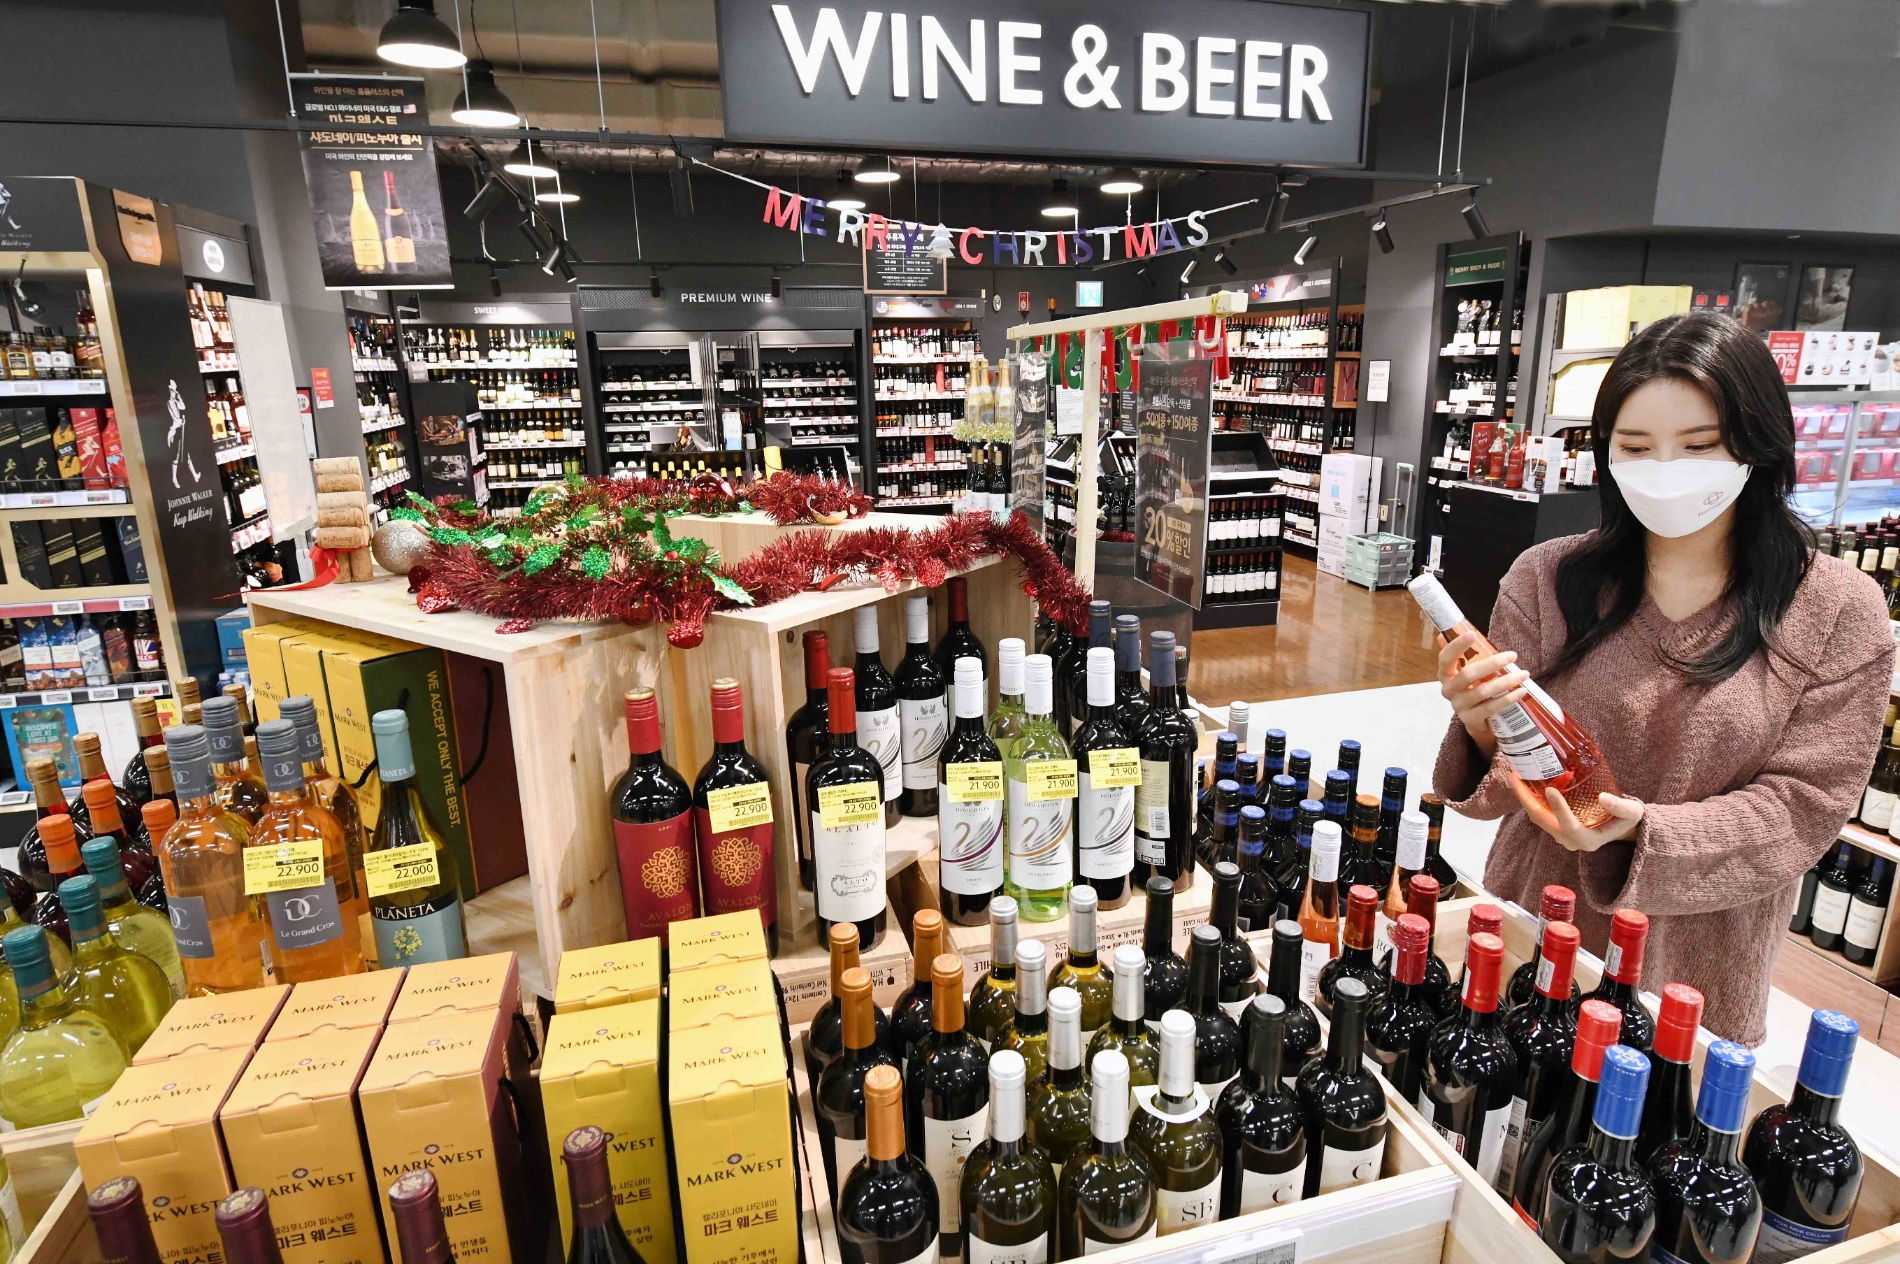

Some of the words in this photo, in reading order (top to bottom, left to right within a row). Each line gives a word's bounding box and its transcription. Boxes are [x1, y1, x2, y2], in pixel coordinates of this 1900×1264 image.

[771, 4, 1043, 105] WINE
[1063, 23, 1122, 110] &
[1141, 31, 1333, 122] BEER
[763, 186, 923, 257] MERRY
[958, 210, 1208, 265] CHRISTMAS
[681, 293, 737, 303] PREMIUM
[740, 293, 772, 303] WINE
[474, 306, 497, 314] SWEET
[167, 495, 191, 511] JOHNNIE
[191, 489, 213, 502] WALKER
[173, 513, 187, 527] Keep
[187, 507, 213, 521] Walking
[426, 670, 440, 690] WE
[254, 688, 269, 700] MARK
[315, 707, 325, 718] EST
[430, 693, 448, 738] ACCEPT
[25, 723, 57, 732] DISCOVER
[335, 712, 351, 726] MARK
[350, 719, 367, 733] WEST
[26, 730, 43, 738] LOVE
[28, 736, 47, 744] FIRST
[438, 740, 452, 770] ONLY
[1110, 767, 1139, 777] 21,900
[443, 771, 456, 796] THE
[969, 780, 1000, 791] 21,900
[1047, 778, 1075, 789] 21,900
[446, 795, 461, 828] BEST.
[735, 802, 768, 817] 22,900
[844, 802, 877, 814] 22,900
[277, 862, 319, 878] 22,900
[395, 863, 434, 880] 22,000
[716, 894, 762, 906] AVALON
[648, 902, 693, 921] AVALON
[281, 930, 290, 938] Le
[290, 926, 316, 937] Grand
[316, 920, 335, 932] Cros
[681, 938, 717, 947] MARK
[720, 930, 752, 940] WEST
[187, 939, 204, 947] Cros
[570, 968, 608, 979] MARK
[612, 961, 647, 972] WEST
[411, 985, 451, 996] MARK
[456, 977, 493, 988] WEST
[682, 994, 721, 1004] MARK
[724, 985, 760, 996] WEST
[790, 981, 816, 992] Contents
[801, 989, 827, 1000] Contents
[292, 1003, 334, 1015] MARK
[339, 995, 378, 1006] WEST
[166, 1022, 210, 1033] MARK
[216, 1014, 257, 1025] WEST
[558, 1038, 601, 1050] MARK
[605, 1029, 643, 1041] WEST
[385, 1048, 429, 1061] MARK
[435, 1039, 474, 1052] WEST
[684, 1057, 727, 1070] MARK
[730, 1048, 768, 1060] WEST
[253, 1069, 300, 1082] MARK
[306, 1059, 348, 1072] WEST
[112, 1093, 162, 1108] MARK
[169, 1083, 215, 1097] WEST
[612, 1136, 657, 1154] WEST
[951, 1129, 972, 1149] S
[382, 1158, 435, 1178] MARK
[438, 1148, 484, 1166] WEST
[686, 1167, 735, 1188] MARK
[740, 1157, 783, 1175] WEST
[1352, 1161, 1372, 1180] C
[263, 1182, 304, 1199] ARK
[306, 1171, 356, 1191] WEST
[1272, 1183, 1293, 1204] C
[447, 1189, 481, 1203] 피노누아
[613, 1187, 652, 1207] 웨스트
[169, 1200, 220, 1219] WEST
[441, 1199, 483, 1218] 웨스트
[703, 1206, 743, 1222] 캘리포니아
[745, 1198, 778, 1212] 샤도네이
[1181, 1198, 1213, 1223] SB
[319, 1212, 355, 1225] 피노누아
[704, 1217, 733, 1237] 마크
[736, 1209, 779, 1229] 웨스트
[277, 1233, 307, 1251] 마크
[310, 1223, 358, 1242] 웨스트
[460, 1236, 487, 1249] 인생을
[183, 1241, 220, 1256] 피노누아
[741, 1248, 776, 1262] 기후에서
